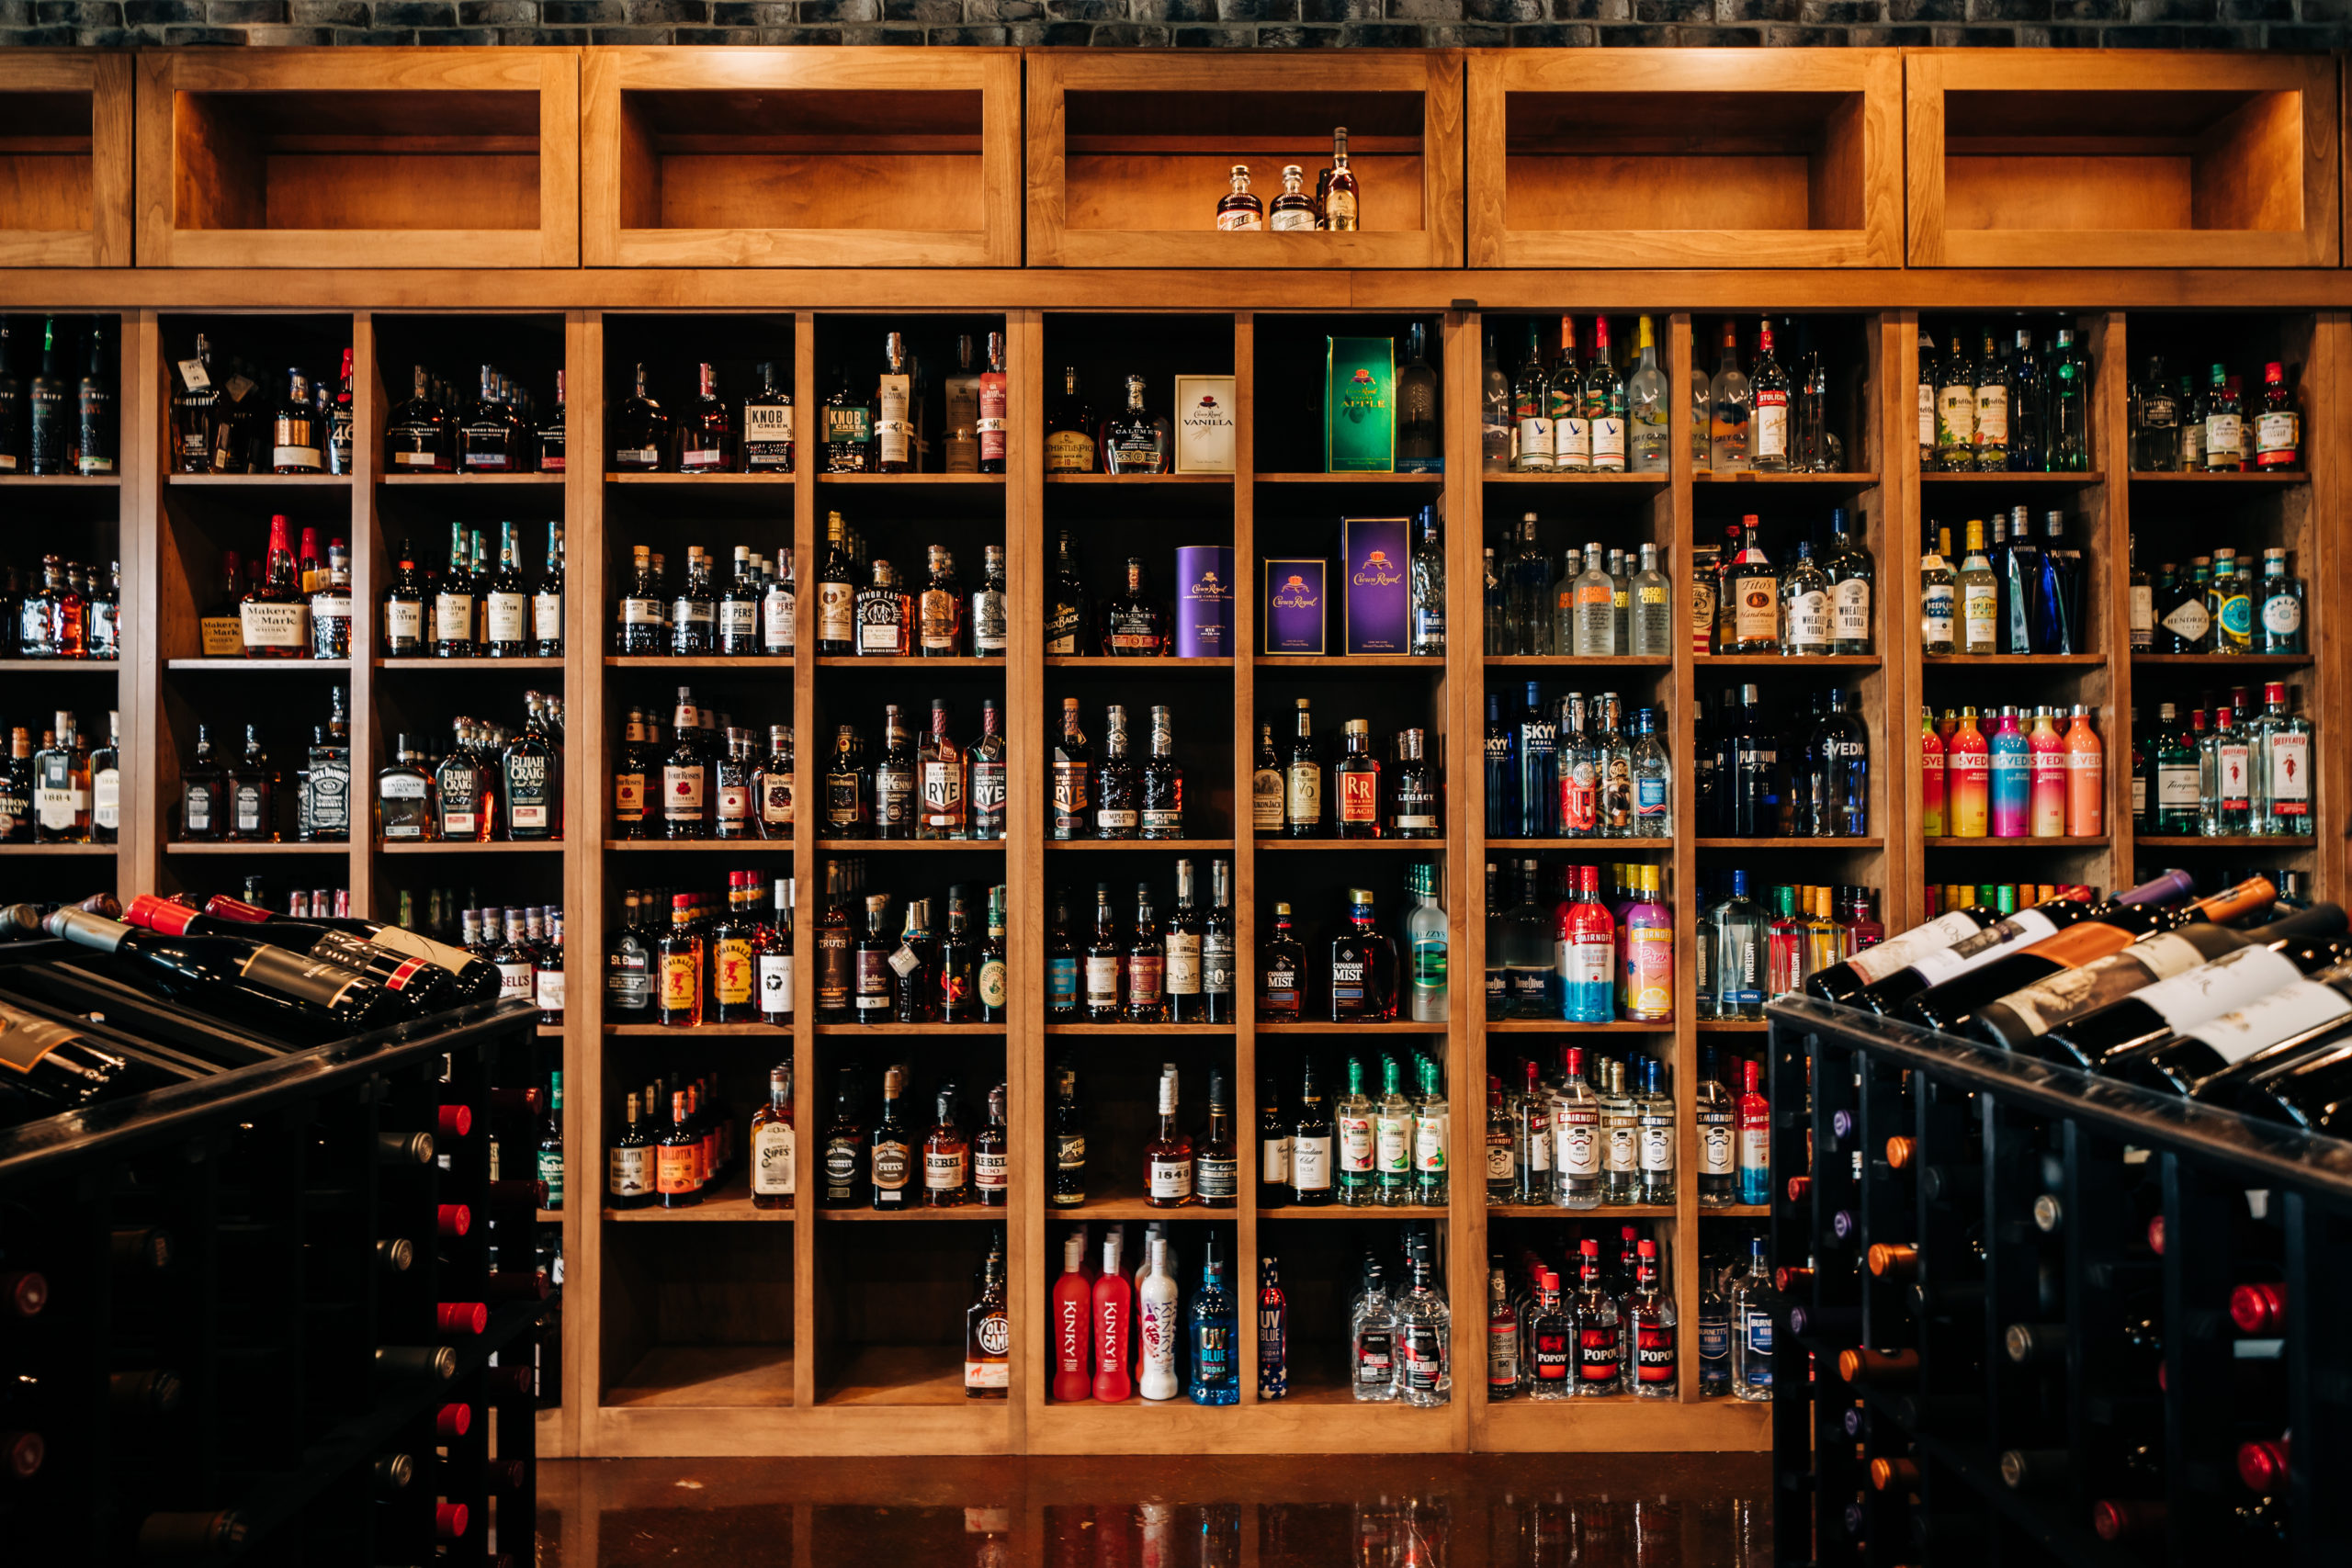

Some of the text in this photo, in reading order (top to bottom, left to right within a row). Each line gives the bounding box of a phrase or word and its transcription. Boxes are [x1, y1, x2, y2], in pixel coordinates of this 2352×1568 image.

[1340, 400, 1385, 408] APPLE
[752, 410, 782, 423] KNOB
[830, 411, 862, 425] KNOB
[2051, 550, 2081, 559] PLATINUM
[1353, 572, 1402, 586] Crown Royal
[1192, 583, 1228, 594] Crown Royal
[1578, 586, 1611, 595] ABSOLUT
[1742, 580, 1771, 591] Tito's
[856, 592, 882, 602] MINOR
[1638, 587, 1668, 596] ABSOLUT
[1272, 595, 1318, 609] Crown Royal
[1641, 595, 1668, 604] CITRON
[247, 606, 297, 615] Maker's
[1838, 606, 1867, 616] WHEATLEY
[203, 621, 240, 629] Maker's
[261, 616, 297, 626] Mark
[1802, 615, 1826, 626] WHEATLEY
[1844, 616, 1864, 627] VODKA
[1807, 626, 1824, 635] VODKA
[1522, 724, 1556, 739] SKYY
[2273, 737, 2306, 747] BEEFEATER
[1740, 750, 1777, 763] PLATINUM
[2222, 748, 2248, 756] BEEFEATER
[511, 754, 545, 768] ELIJAH
[1959, 755, 1988, 765] SVED
[1753, 762, 1765, 773] 7X
[310, 768, 349, 782] JACK DANIEL'S
[444, 769, 472, 781] ELIJAH
[511, 767, 545, 780] CRAIG
[667, 771, 701, 780] Four Roses
[444, 780, 472, 791] CRAIG
[929, 782, 958, 805] RYE
[976, 786, 1005, 806] RYE
[1056, 785, 1086, 803] RYE
[1268, 801, 1282, 809] JACK
[1575, 933, 1612, 943] SMIRNOFF
[818, 939, 846, 949] TRUTH
[716, 944, 752, 961] FIREBALL
[1639, 946, 1668, 964] Pink
[662, 958, 694, 970] FIREBALL
[1745, 942, 1755, 983] AMSTERDAM
[1333, 969, 1363, 981] MIST
[1791, 952, 1801, 988] AMSTERDAM
[1268, 977, 1294, 987] MIST
[1514, 975, 1544, 988] Three Olives
[1559, 1112, 1599, 1122] SMIRNOFF
[1603, 1118, 1636, 1127] SMIRNOFF
[1639, 1117, 1673, 1126] SMIRNOFF
[1698, 1113, 1735, 1122] SMIRNOFF
[1292, 1146, 1323, 1155] Canadian
[927, 1156, 960, 1168] REBEL
[975, 1155, 1007, 1167] REBEL
[1299, 1156, 1316, 1164] Club
[1260, 1310, 1280, 1329] UV
[986, 1322, 1008, 1335] OLD
[1063, 1300, 1077, 1358] KINKY
[1103, 1301, 1117, 1358] KINKY
[1160, 1301, 1173, 1356] KINKY
[1201, 1327, 1227, 1349] UV
[1260, 1328, 1280, 1342] BLUE
[1202, 1349, 1226, 1361] BLUE
[1363, 1355, 1388, 1364] PREMIUM
[1537, 1353, 1567, 1362] POPOV
[1583, 1348, 1617, 1360] POPOV
[1202, 1365, 1226, 1373] VODKA
[1406, 1360, 1439, 1371] PREMIUM
